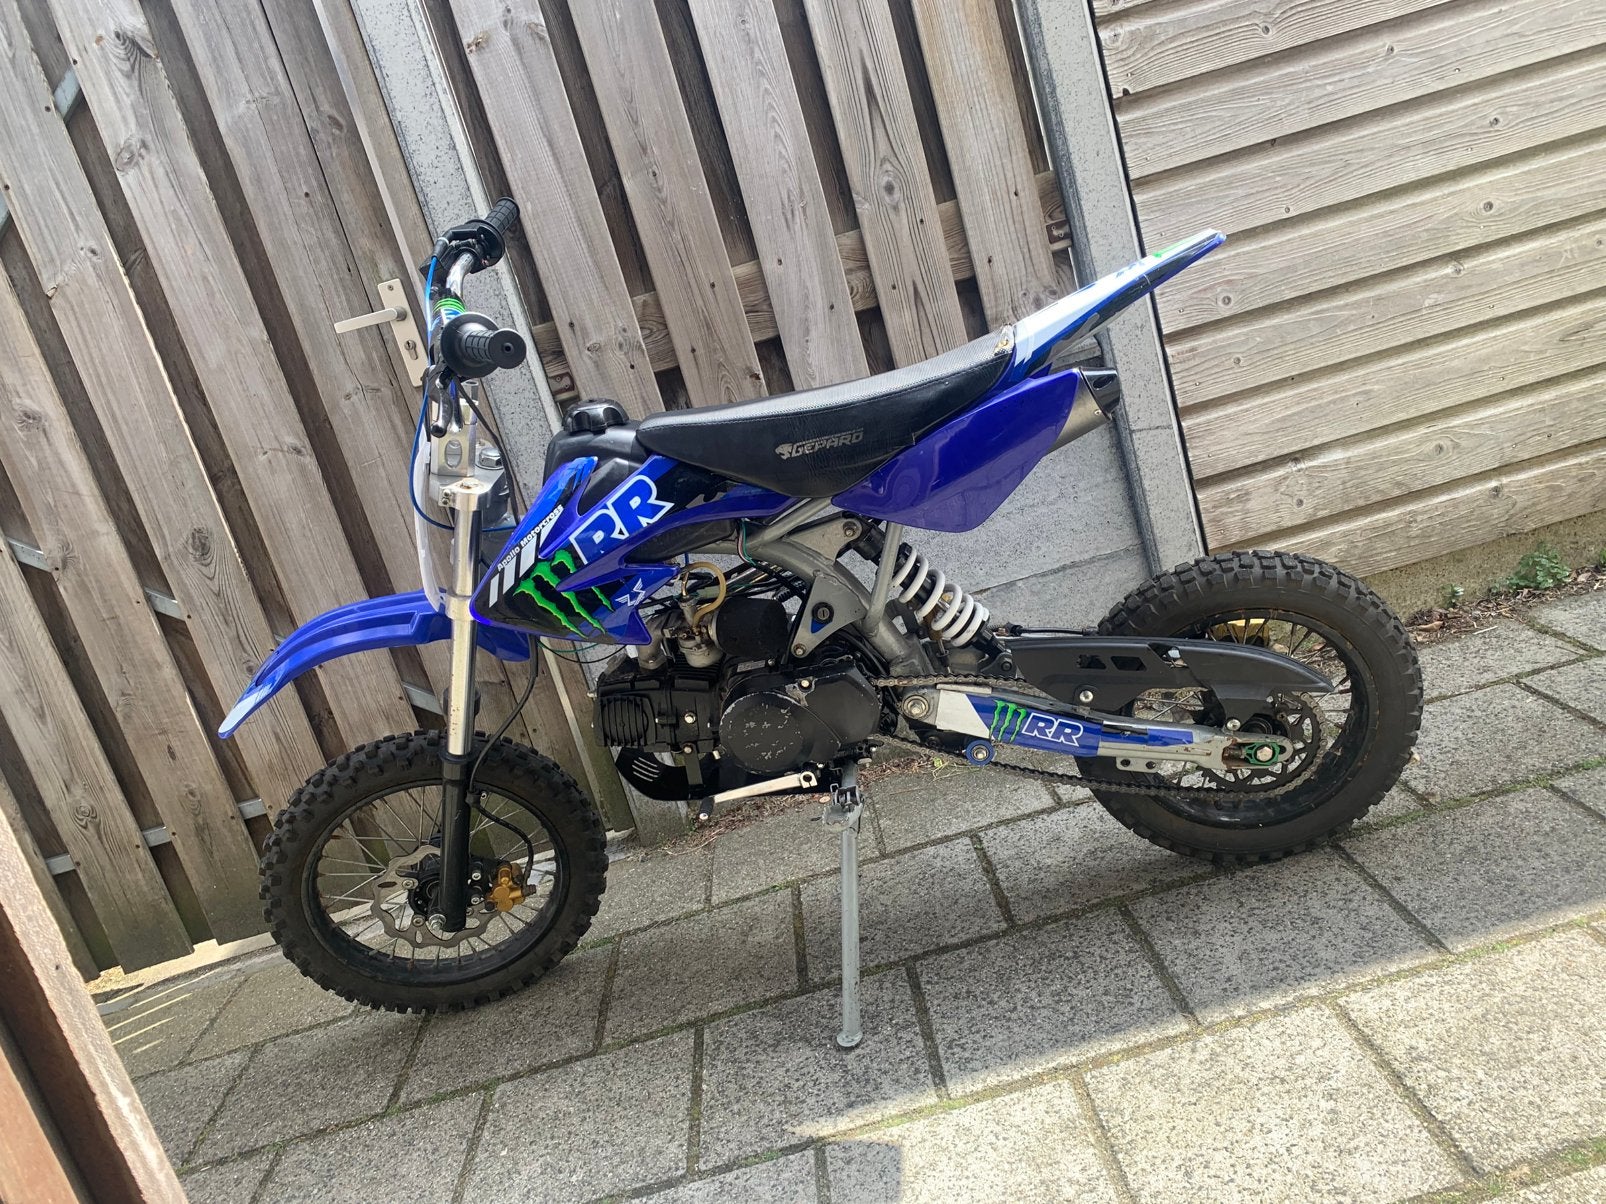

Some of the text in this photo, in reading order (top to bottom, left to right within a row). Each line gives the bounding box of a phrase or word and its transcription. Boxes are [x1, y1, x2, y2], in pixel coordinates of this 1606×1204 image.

[791, 430, 864, 457] GEPARD
[497, 504, 564, 571] Apollo Motorcross
[1021, 712, 1084, 747] RR
